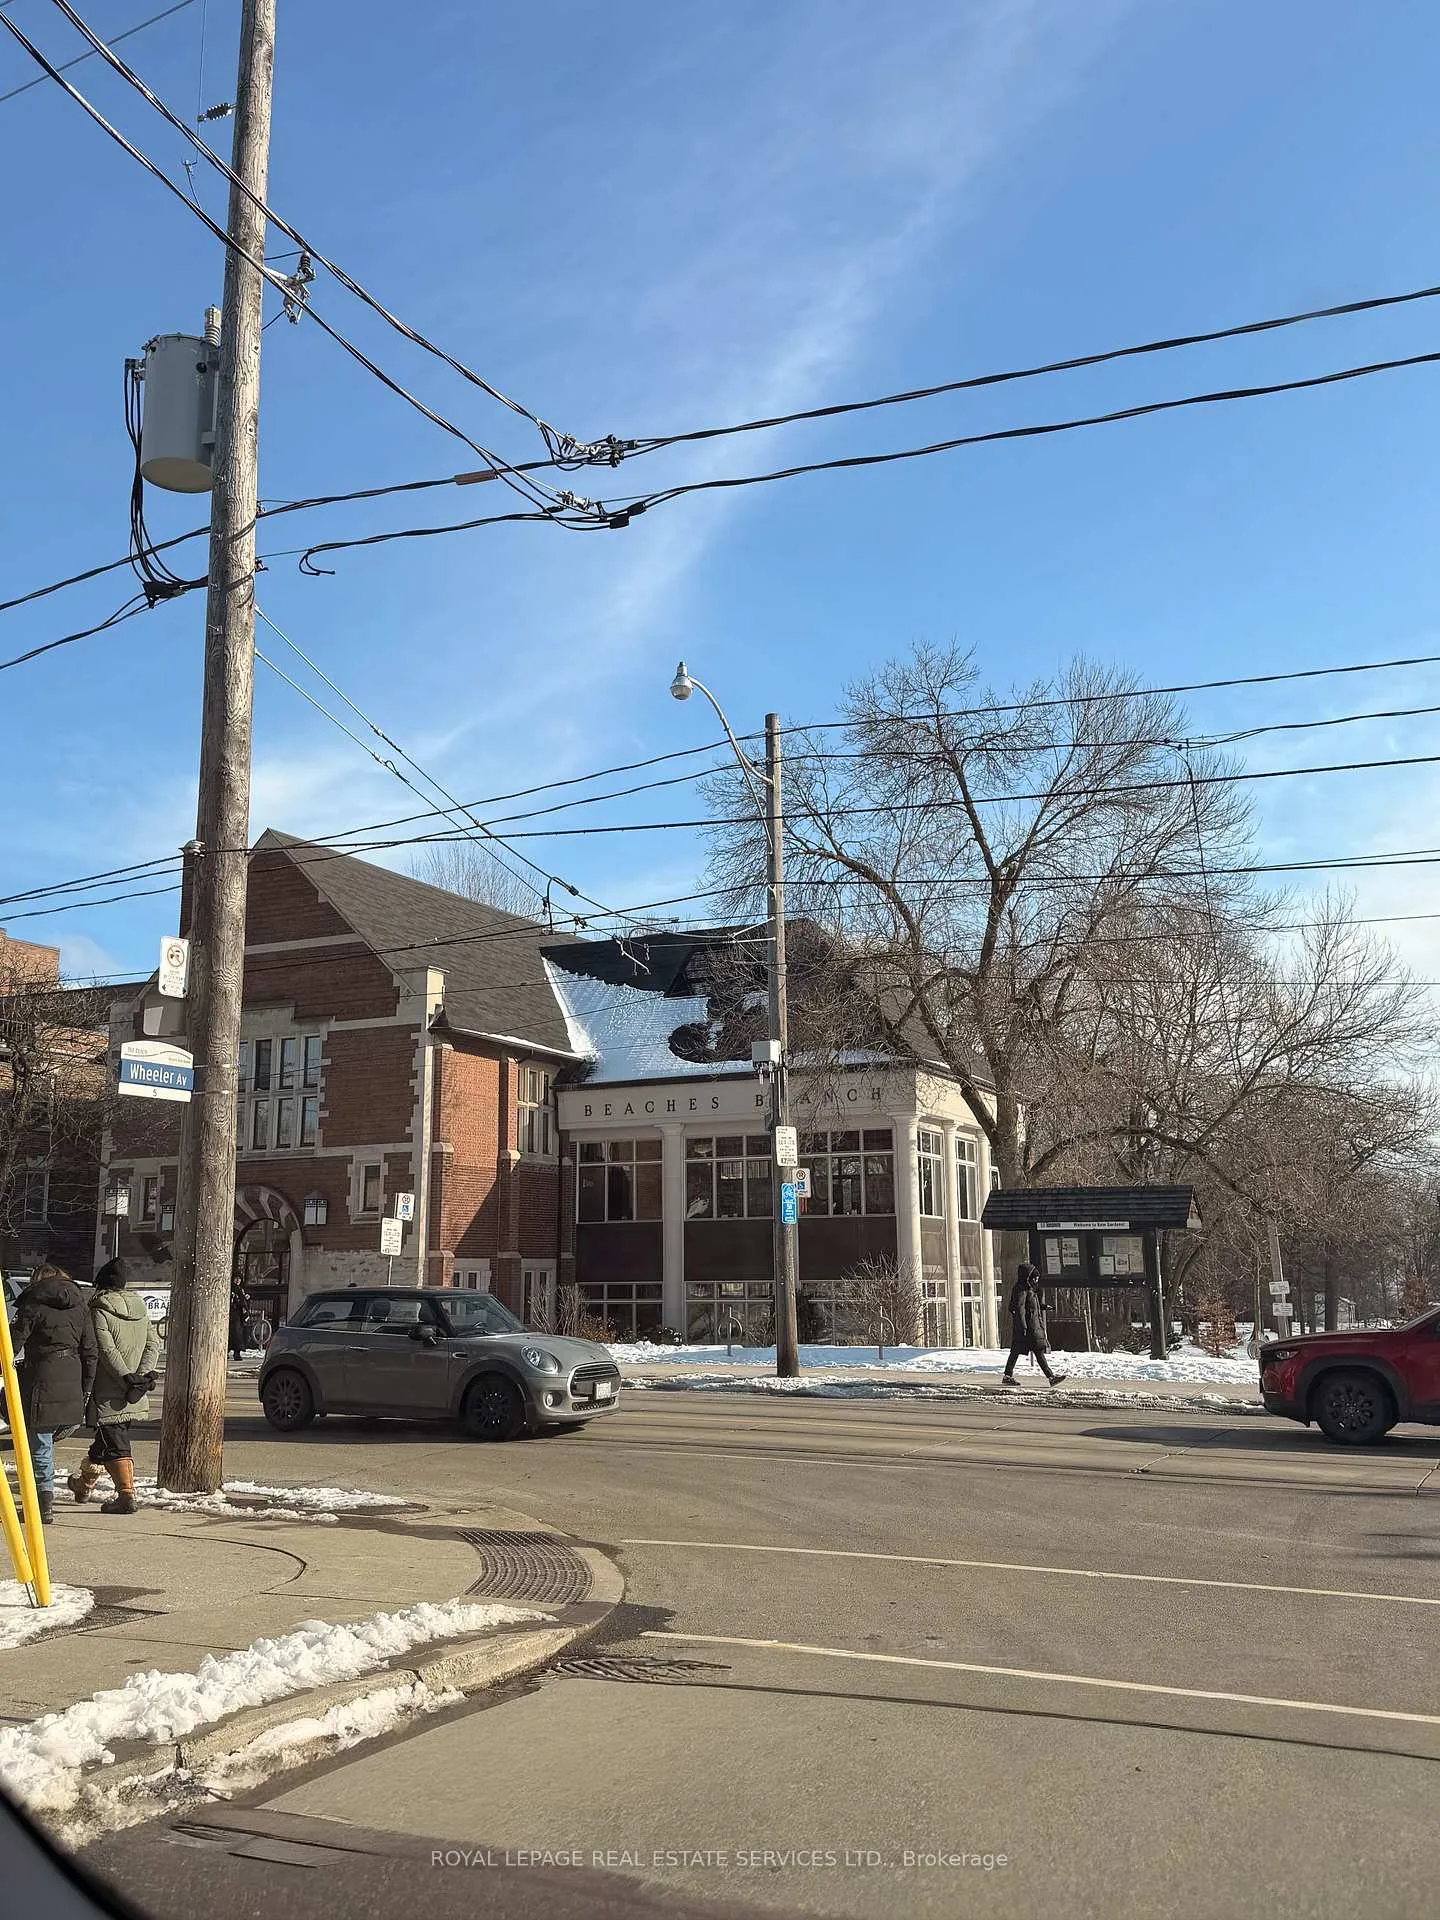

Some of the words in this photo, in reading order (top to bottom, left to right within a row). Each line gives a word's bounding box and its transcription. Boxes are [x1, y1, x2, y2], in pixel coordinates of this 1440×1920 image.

[130, 1063, 174, 1084] Wheeler
[176, 1073, 187, 1086] Av
[584, 1097, 719, 1117] BEACHES
[755, 1087, 881, 1107] BANCH
